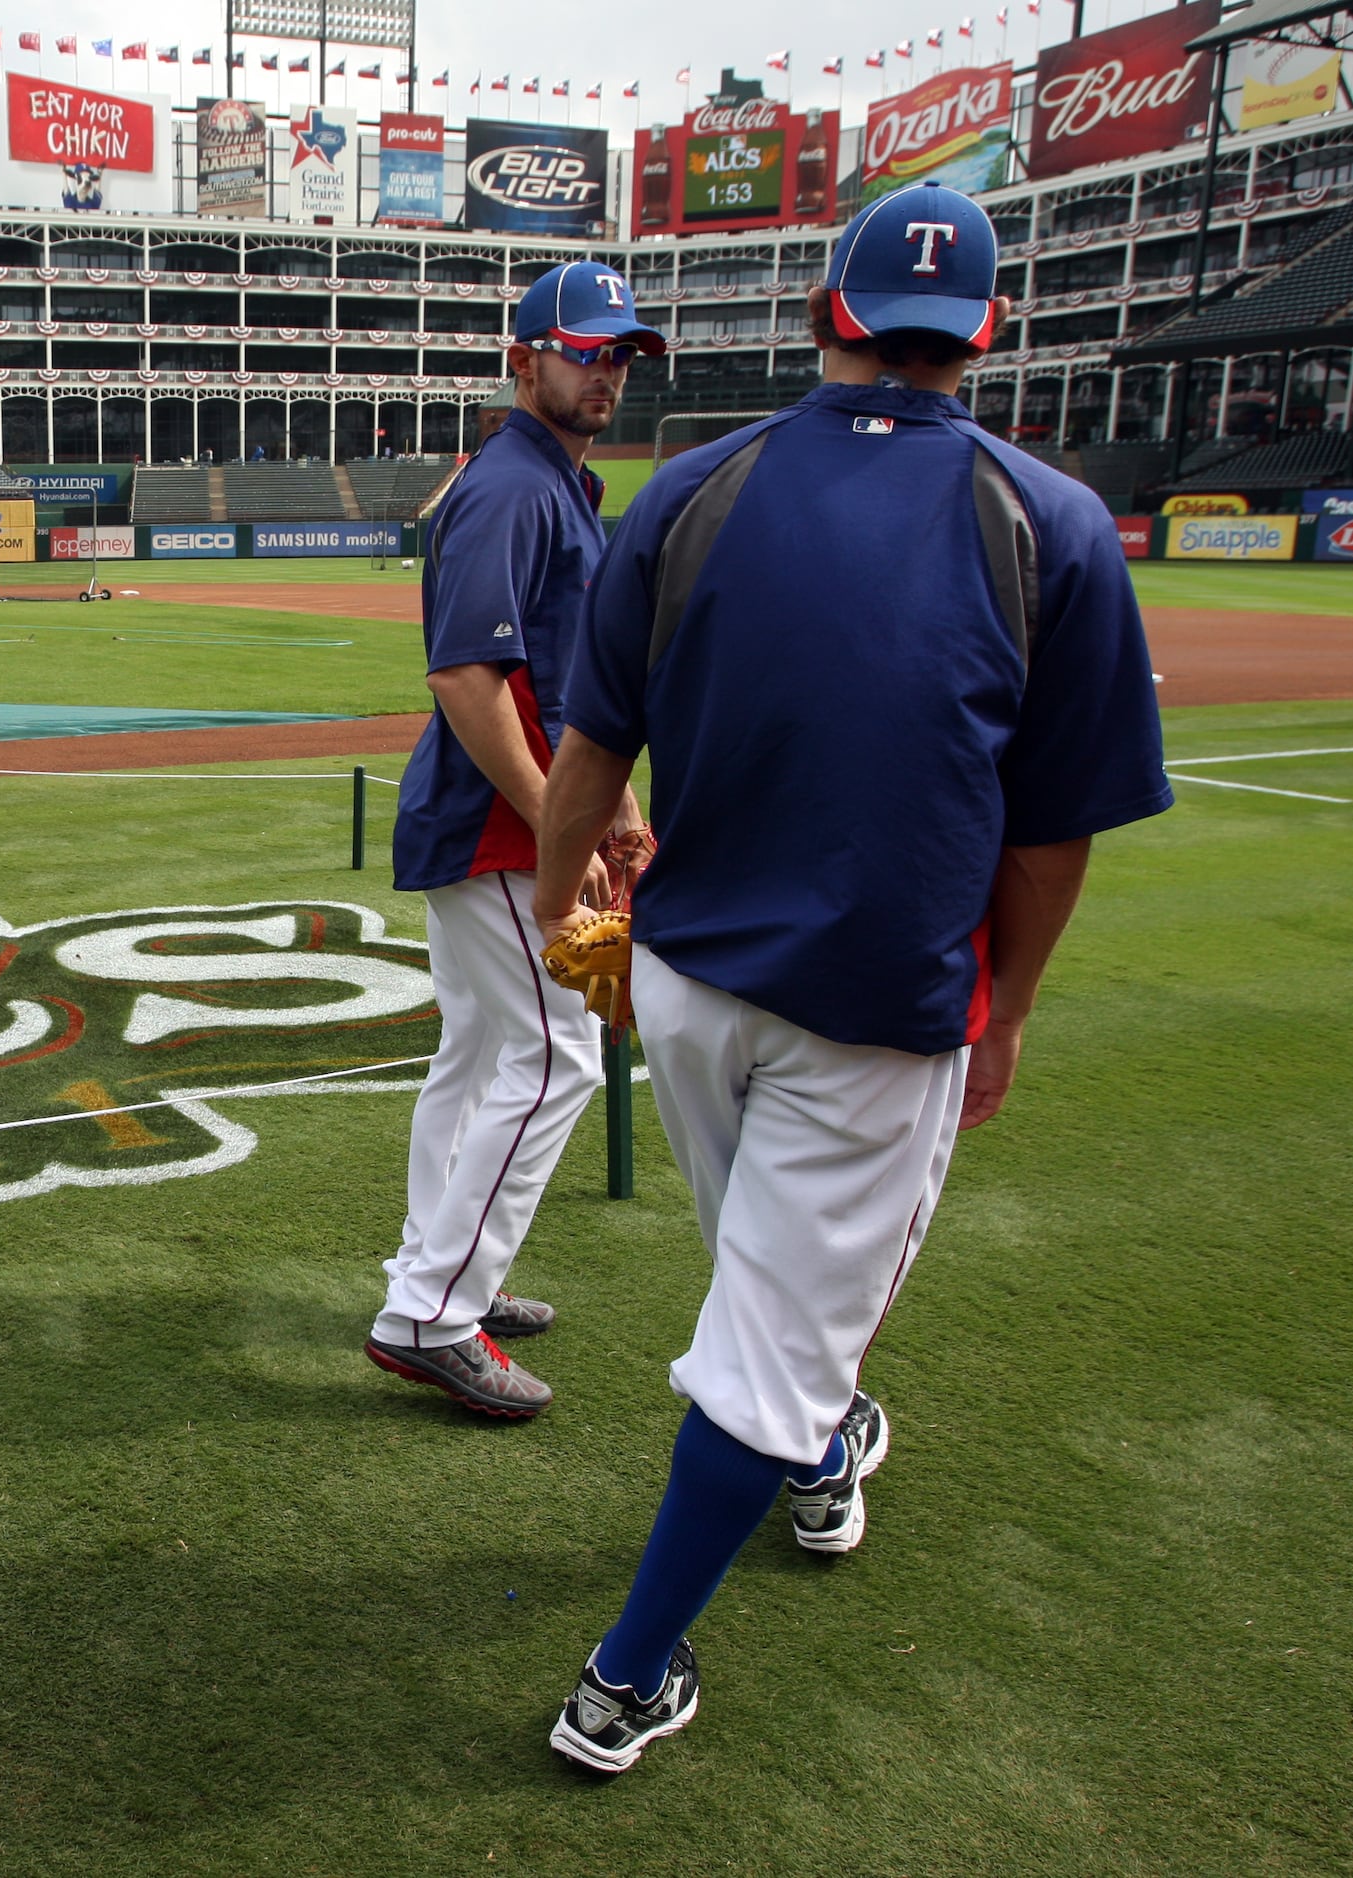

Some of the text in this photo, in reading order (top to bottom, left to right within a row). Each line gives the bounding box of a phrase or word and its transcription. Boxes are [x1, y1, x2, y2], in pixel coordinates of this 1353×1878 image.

[1038, 51, 1203, 142] Bud
[29, 90, 123, 131] EAT MOR
[693, 98, 777, 134] Coca-Cola
[867, 78, 1001, 168] Ozarka
[47, 122, 130, 160] CHIKIN
[202, 142, 262, 159] FOLLOW THE
[200, 152, 265, 174] RANGERS
[499, 152, 585, 179] BUD
[704, 147, 762, 173] ALCS
[302, 169, 344, 185] Grand
[390, 173, 435, 187] GIVE YOUR
[482, 173, 600, 202] LIGHT
[302, 184, 344, 200] Prairie
[387, 186, 436, 200] HAT A REST
[707, 182, 753, 205] 1:53
[302, 199, 345, 213] Ford.com
[905, 222, 957, 277] T
[596, 274, 624, 309] T
[39, 492, 90, 502] Hyundai.com
[52, 536, 131, 558] jcpenney
[152, 533, 234, 549] GEICO
[257, 531, 396, 547] SAMSUNG mobile
[1180, 522, 1281, 557] Snapple
